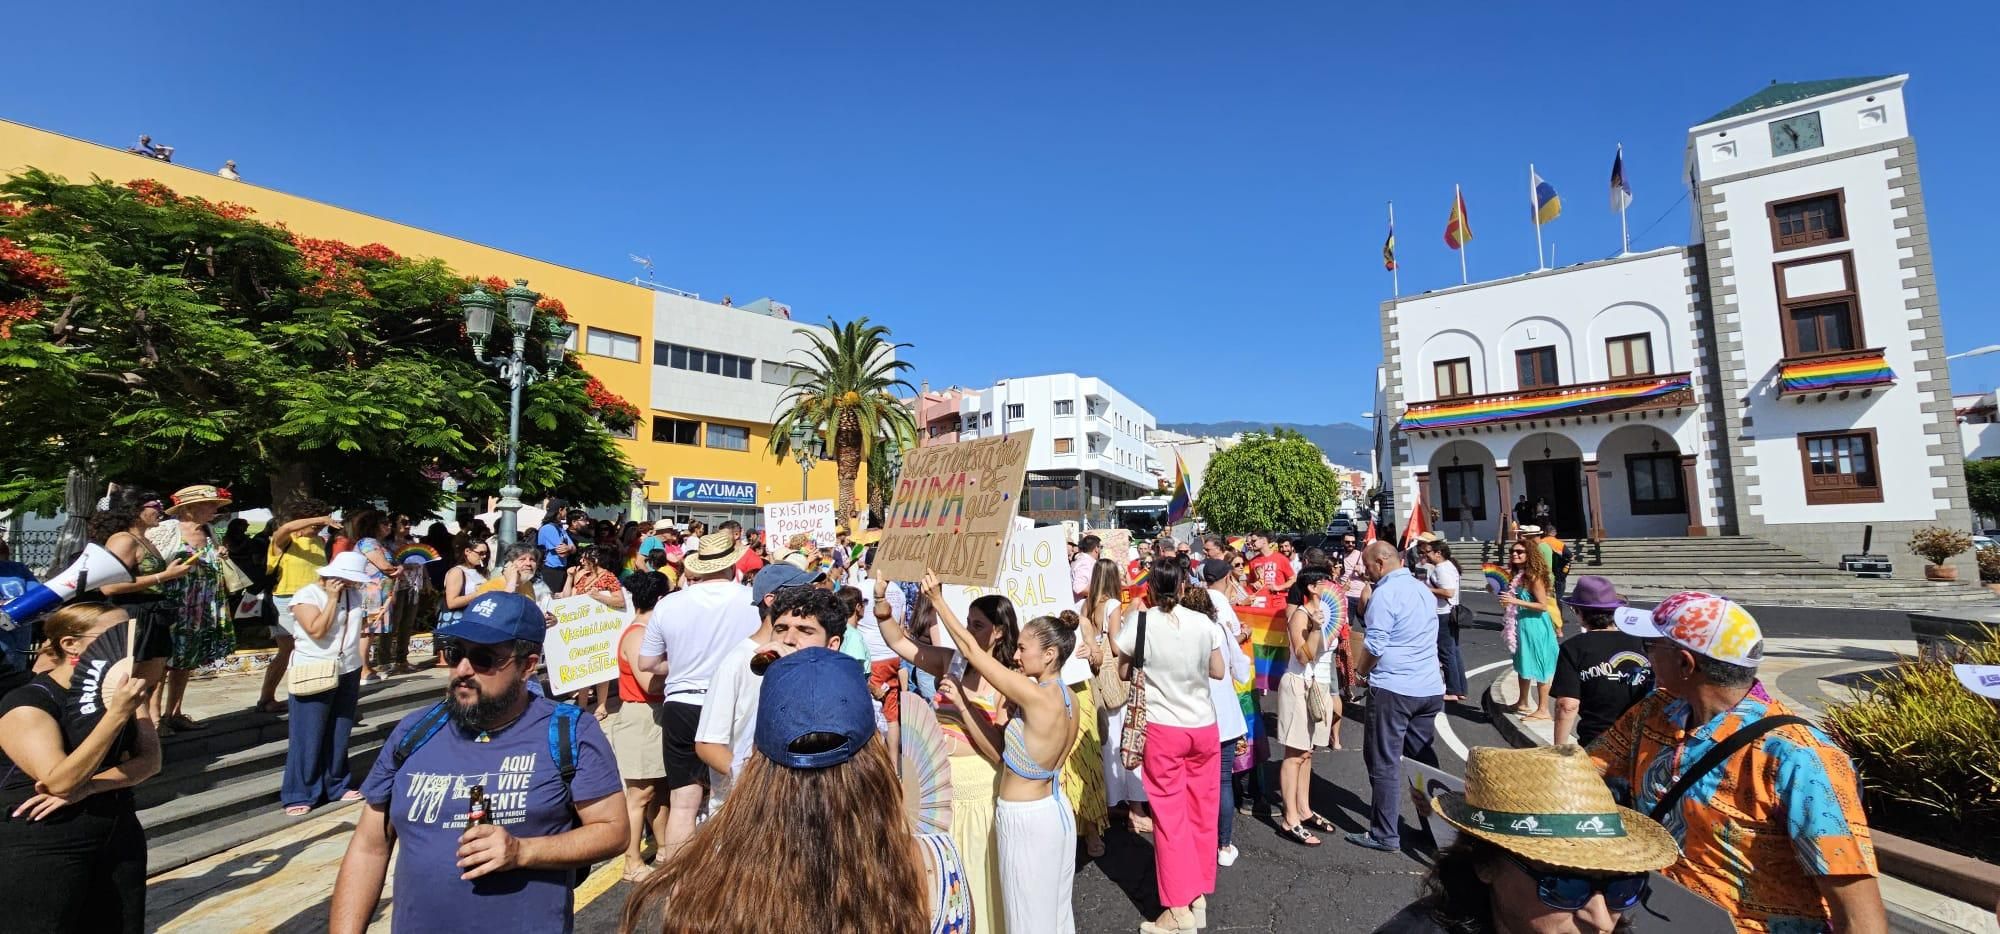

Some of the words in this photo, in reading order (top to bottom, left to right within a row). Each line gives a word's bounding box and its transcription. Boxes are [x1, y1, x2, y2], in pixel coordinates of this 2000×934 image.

[697, 483, 754, 497] AYUMAR
[889, 471, 966, 528] PLUMA
[979, 468, 1007, 492] es
[770, 503, 830, 518] EXISTIMOS
[965, 490, 1001, 532] que
[777, 518, 823, 532] PORQUE
[878, 533, 926, 561] nunca
[559, 652, 618, 684] RESISTEN
[79, 660, 108, 715] BRUJA
[499, 753, 536, 772] AQUÍ
[498, 773, 532, 790] VIVE
